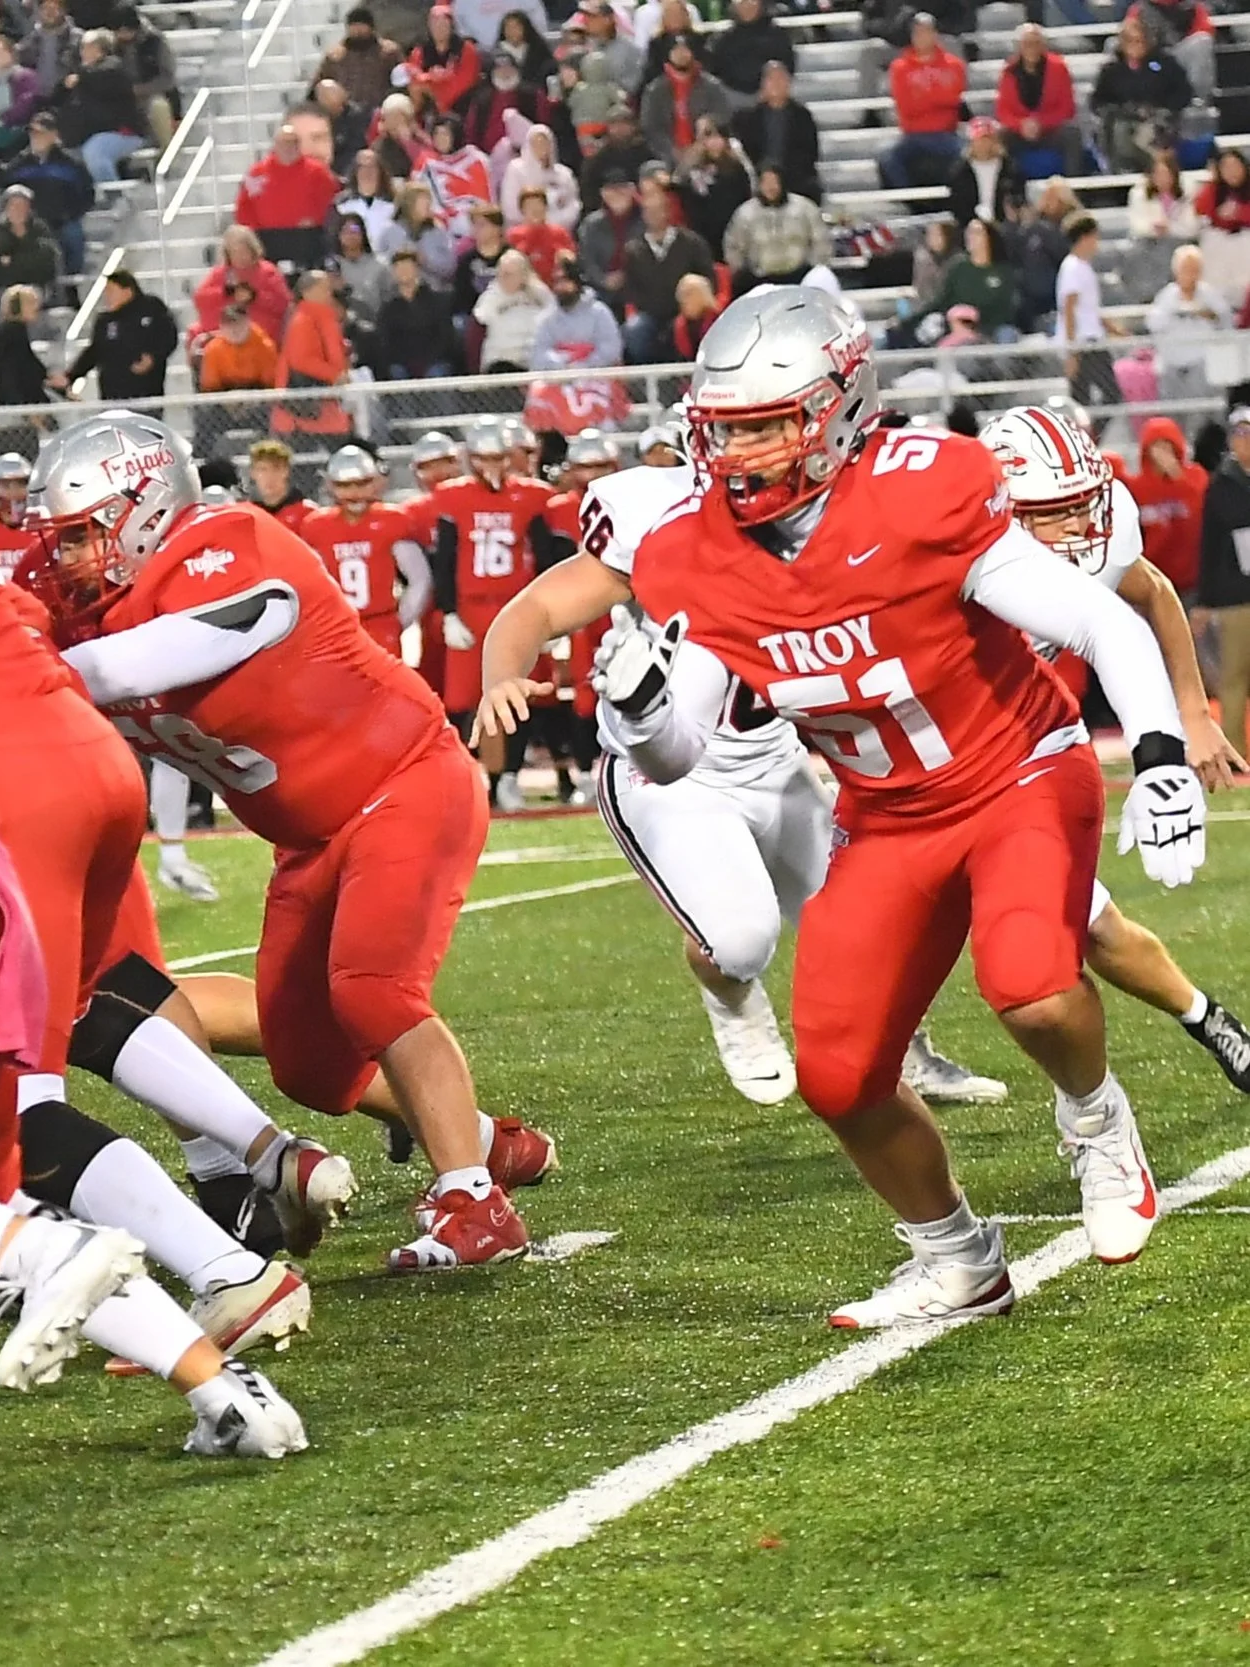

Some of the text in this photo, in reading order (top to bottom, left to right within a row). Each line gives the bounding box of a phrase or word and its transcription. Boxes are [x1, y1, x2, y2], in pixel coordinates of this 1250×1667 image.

[100, 448, 176, 486] Trojans
[468, 529, 517, 578] 16
[580, 496, 614, 559] 56
[338, 559, 370, 609] 9
[757, 614, 879, 675] TROY
[766, 656, 954, 779] 51
